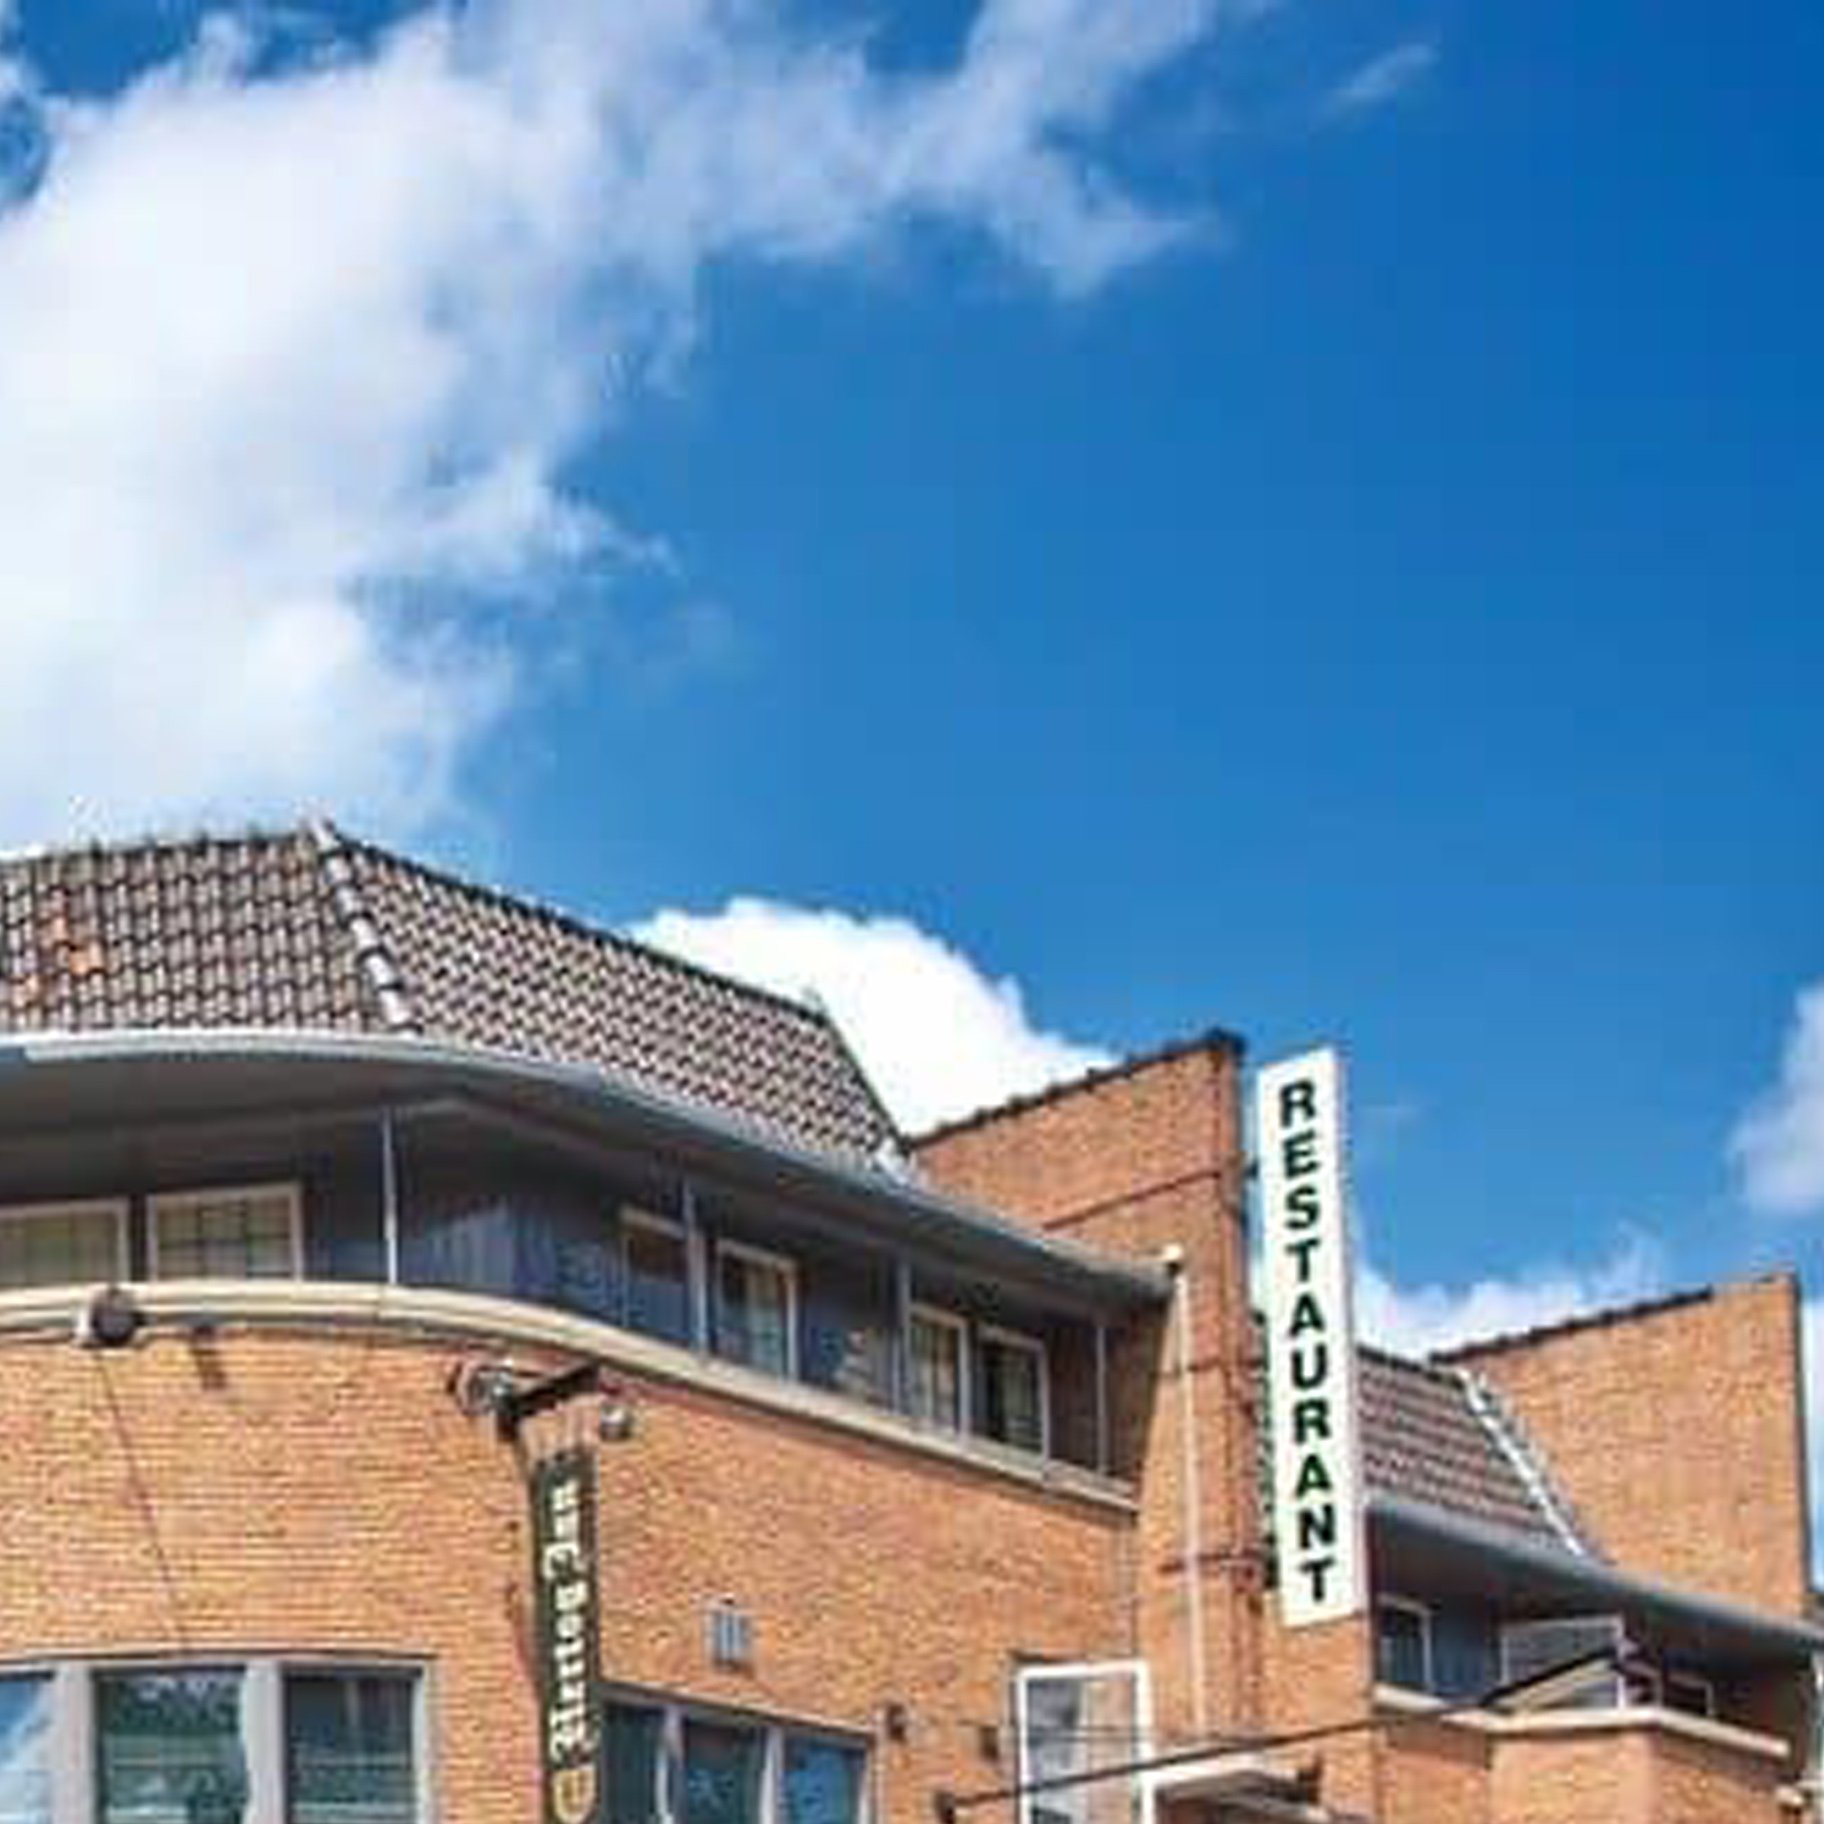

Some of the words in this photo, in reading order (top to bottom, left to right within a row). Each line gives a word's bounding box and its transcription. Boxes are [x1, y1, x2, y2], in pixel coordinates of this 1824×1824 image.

[1279, 1079, 1335, 1603] RESTAURANT
[543, 1478, 588, 1580] Jan
[545, 1582, 598, 1766] Hertog
